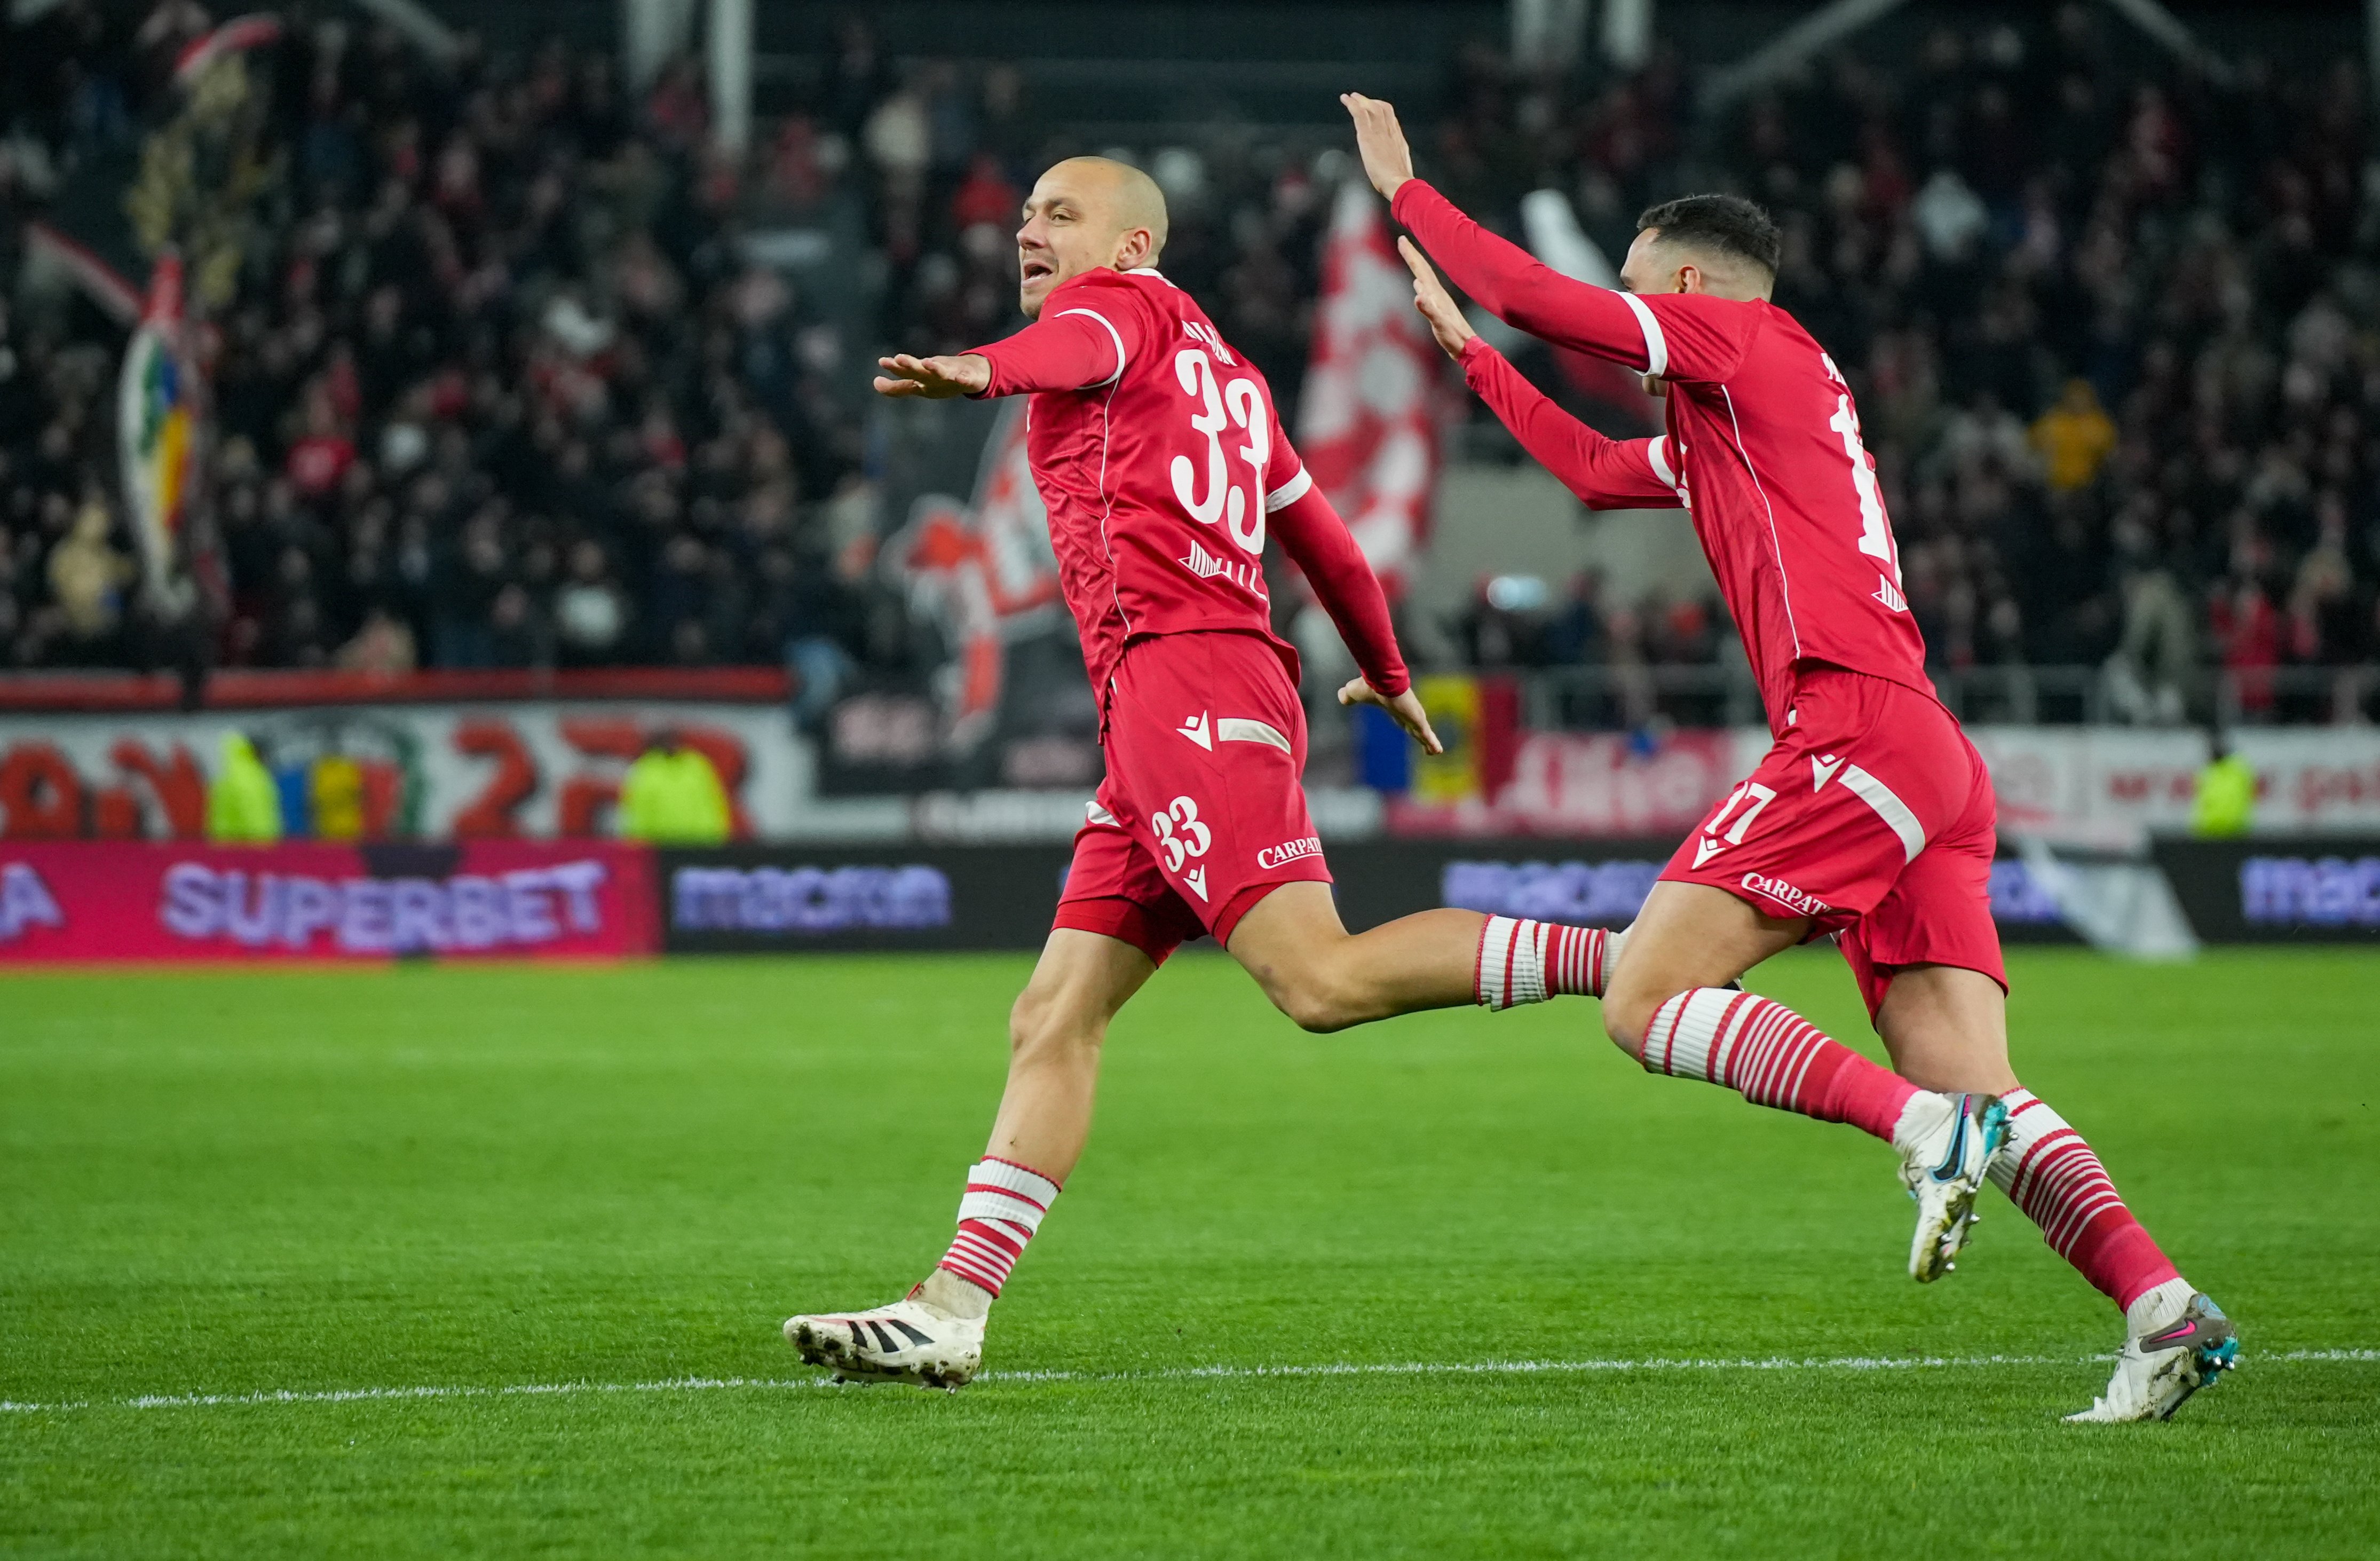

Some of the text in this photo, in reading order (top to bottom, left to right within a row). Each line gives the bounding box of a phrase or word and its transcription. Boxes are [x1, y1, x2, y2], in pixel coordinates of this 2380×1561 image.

[1171, 349, 1268, 555] 33
[1152, 795, 1212, 873] 33
[1704, 781, 1777, 846] 17
[1257, 837, 1323, 870] CARPAT
[160, 860, 607, 953] SUPERBET
[1741, 872, 1833, 916] CARPAT
